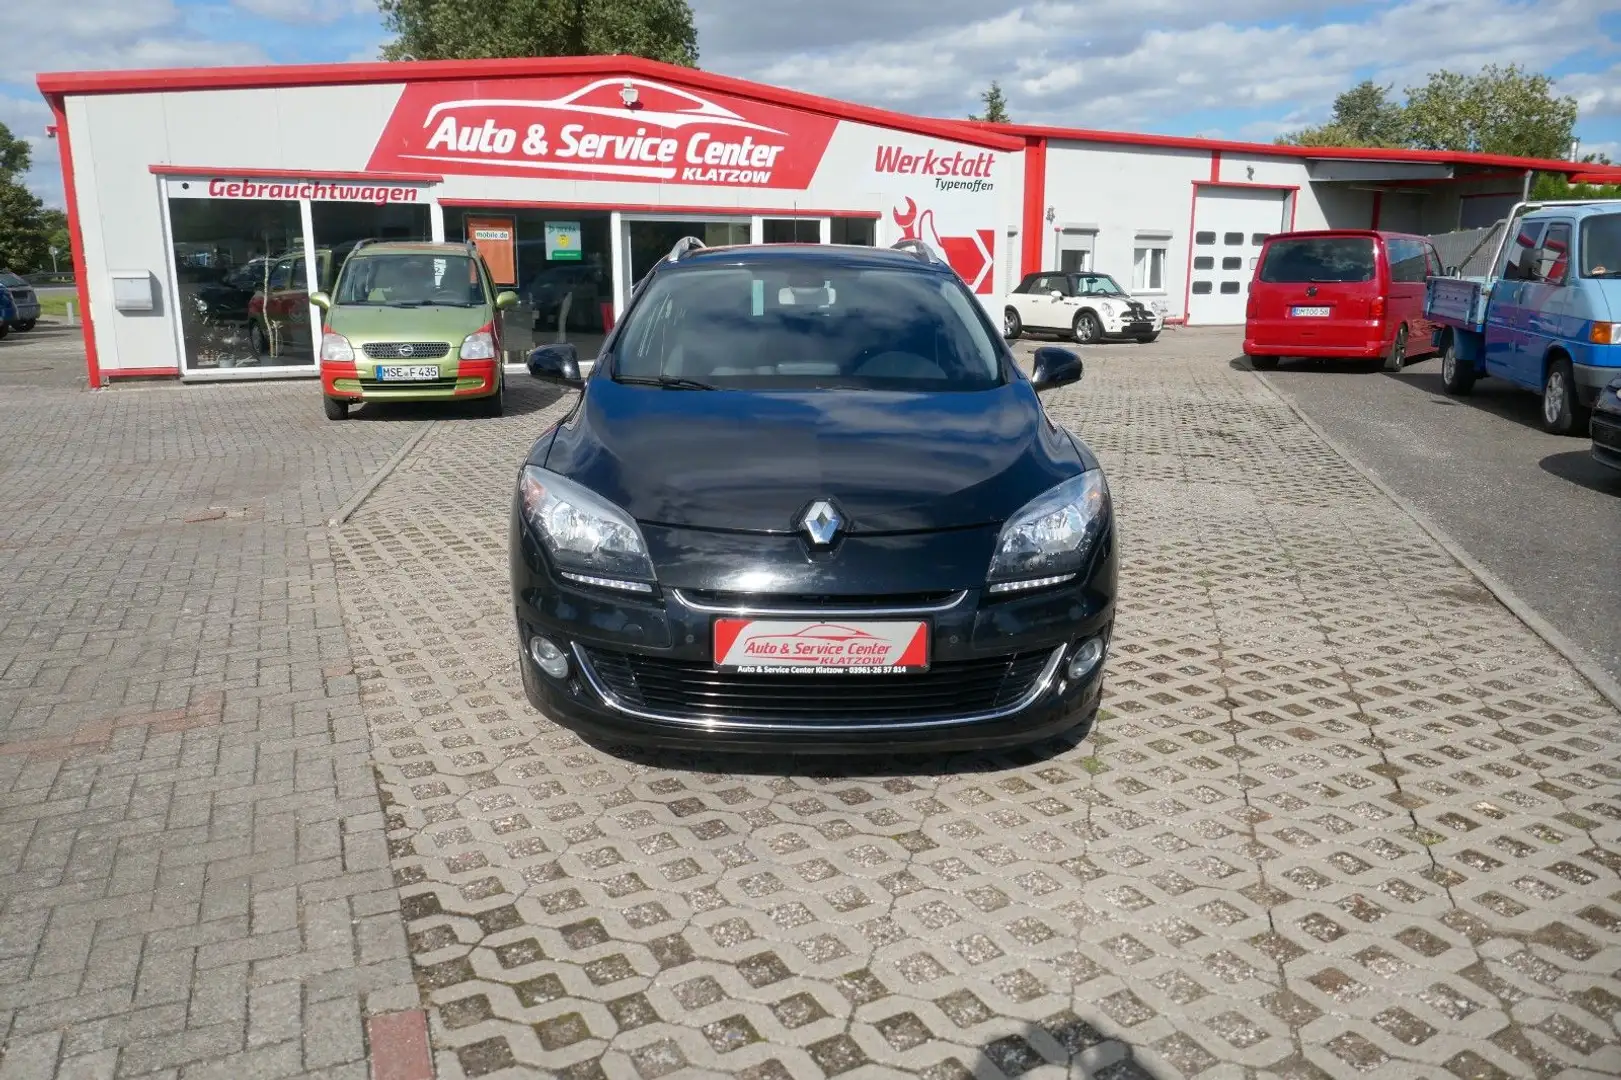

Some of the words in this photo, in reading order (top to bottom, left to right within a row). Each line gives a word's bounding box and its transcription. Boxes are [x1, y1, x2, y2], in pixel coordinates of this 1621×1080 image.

[425, 116, 517, 154] Auto
[522, 123, 549, 156] &
[555, 124, 679, 163] Service
[685, 132, 785, 168] Center
[875, 145, 996, 178] Werkstatt
[681, 167, 771, 184] KLATZOW
[934, 178, 995, 192] Typenoffen
[208, 178, 418, 206] Gebrauchtwagen
[476, 230, 508, 239] mobile.de
[383, 367, 403, 377] MSE
[409, 367, 416, 377] F
[418, 366, 437, 377] 435
[744, 642, 777, 654] Auto
[780, 643, 790, 654] &
[793, 642, 844, 655] Service
[847, 642, 892, 655] Center
[819, 656, 886, 665] KLATZOW
[737, 665, 755, 673] Auto
[815, 666, 844, 674] Klatzow
[849, 666, 882, 674] 03961-26
[883, 666, 892, 674] 37
